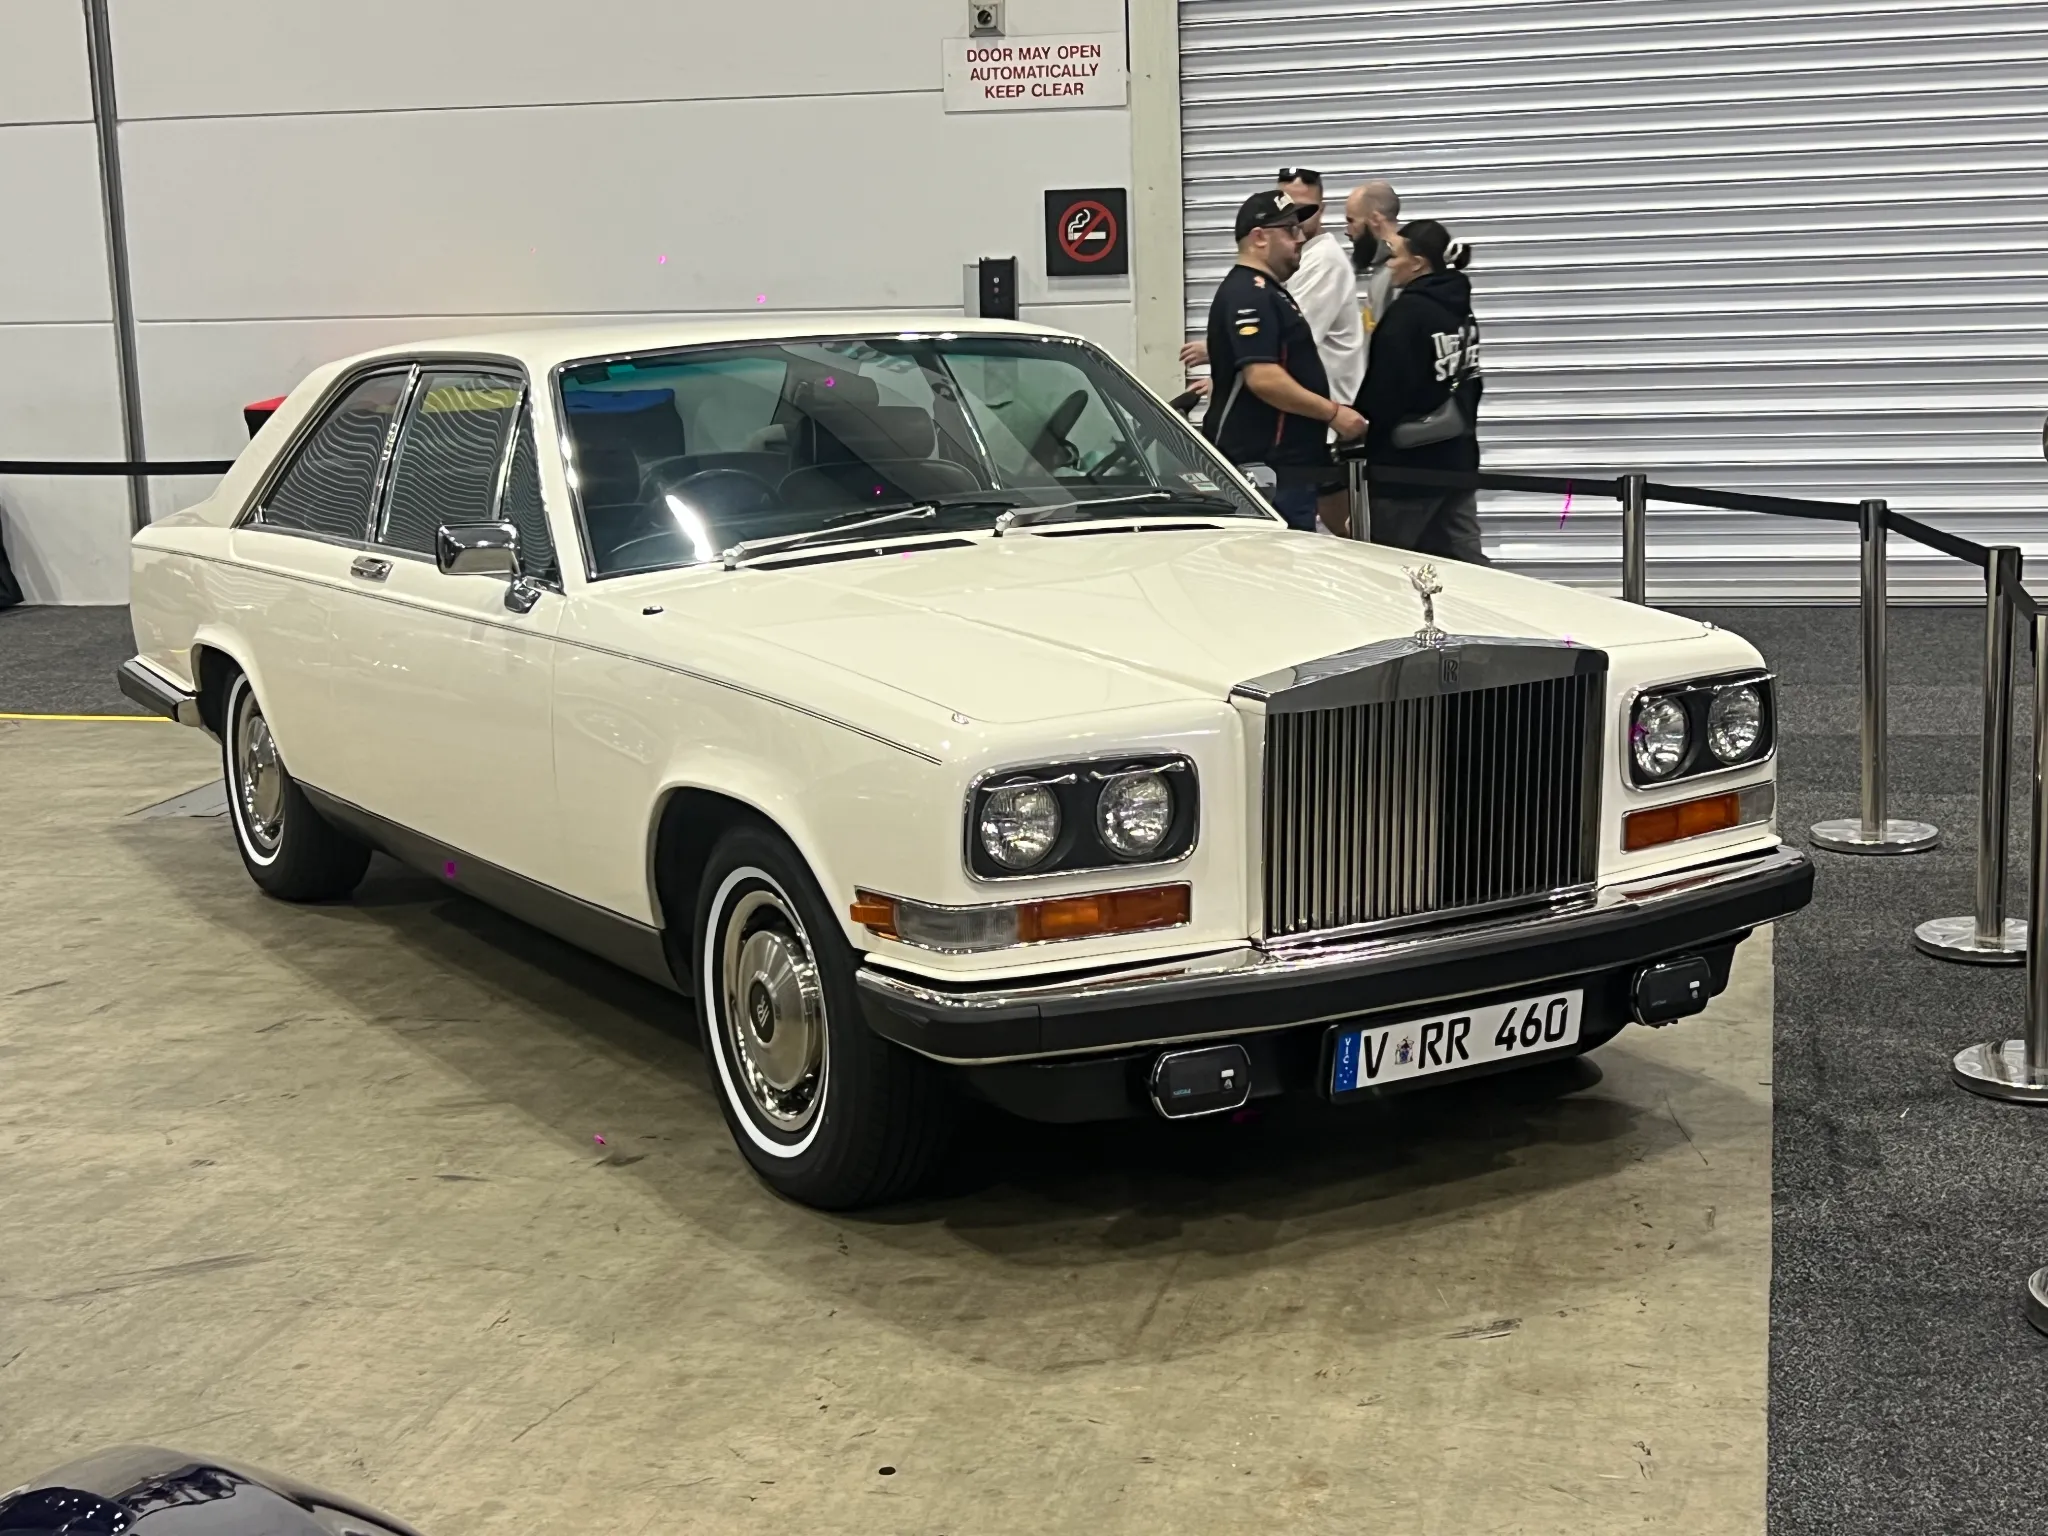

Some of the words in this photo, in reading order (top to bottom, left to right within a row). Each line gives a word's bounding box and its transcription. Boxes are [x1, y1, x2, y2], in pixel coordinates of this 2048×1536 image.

[966, 48, 1013, 63] DOOR
[1018, 46, 1051, 61] MAY
[1057, 44, 1101, 59] OPEN
[970, 63, 1099, 81] AUTOMATICALLY
[984, 85, 1026, 99] KEEP
[1031, 82, 1084, 97] CLEAR
[1494, 998, 1568, 1051] 460
